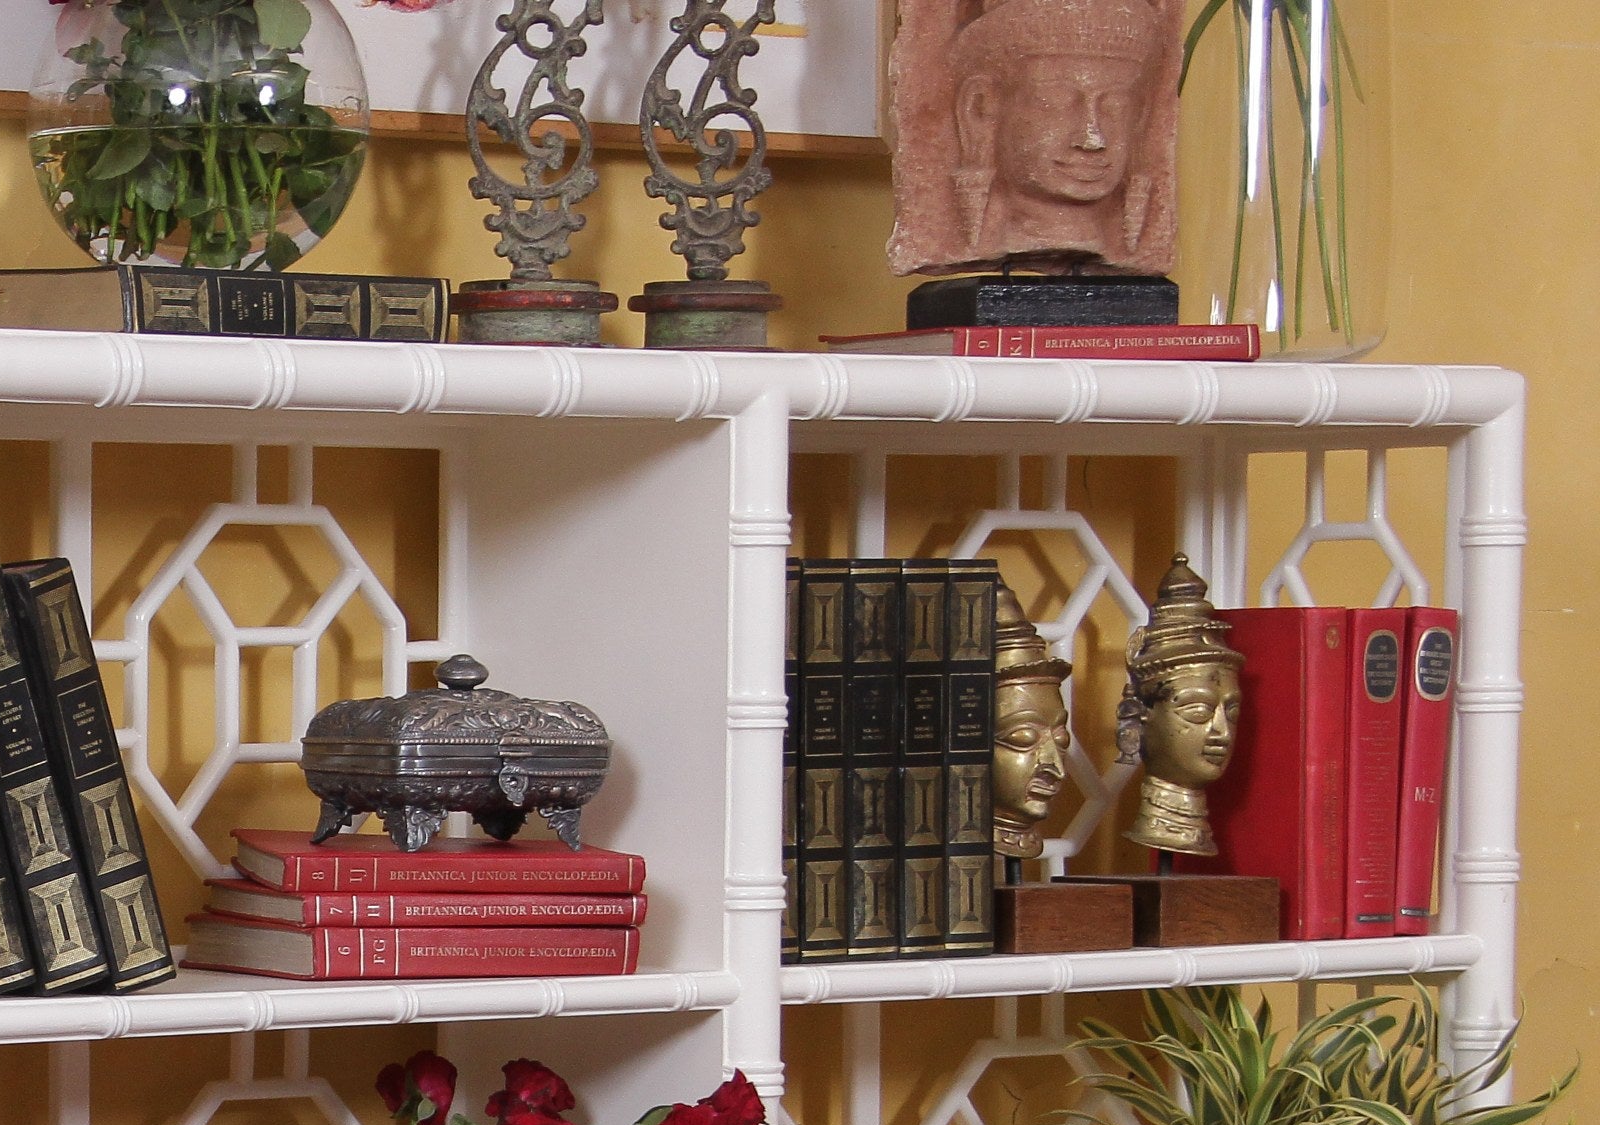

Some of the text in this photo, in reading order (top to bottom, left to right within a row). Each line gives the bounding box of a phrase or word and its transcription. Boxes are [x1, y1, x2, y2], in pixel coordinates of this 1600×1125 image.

[1045, 335, 1241, 349] BRITANNICA JUNIOR ENCYCLOPÆDIA
[1414, 787, 1435, 803] M-Z
[312, 871, 325, 880] 8
[389, 870, 619, 884] BRITANNICA JUNIOR ENCYCLOPÆDIA
[330, 906, 343, 915] 7
[405, 905, 624, 918] BRITANNICA JUNIOR ENCYCLOPÆDIA
[338, 946, 350, 955] 6
[374, 939, 386, 964] FG
[410, 947, 616, 960] BRITANNICA JUNIOR ENCYCLOPÆDIA
